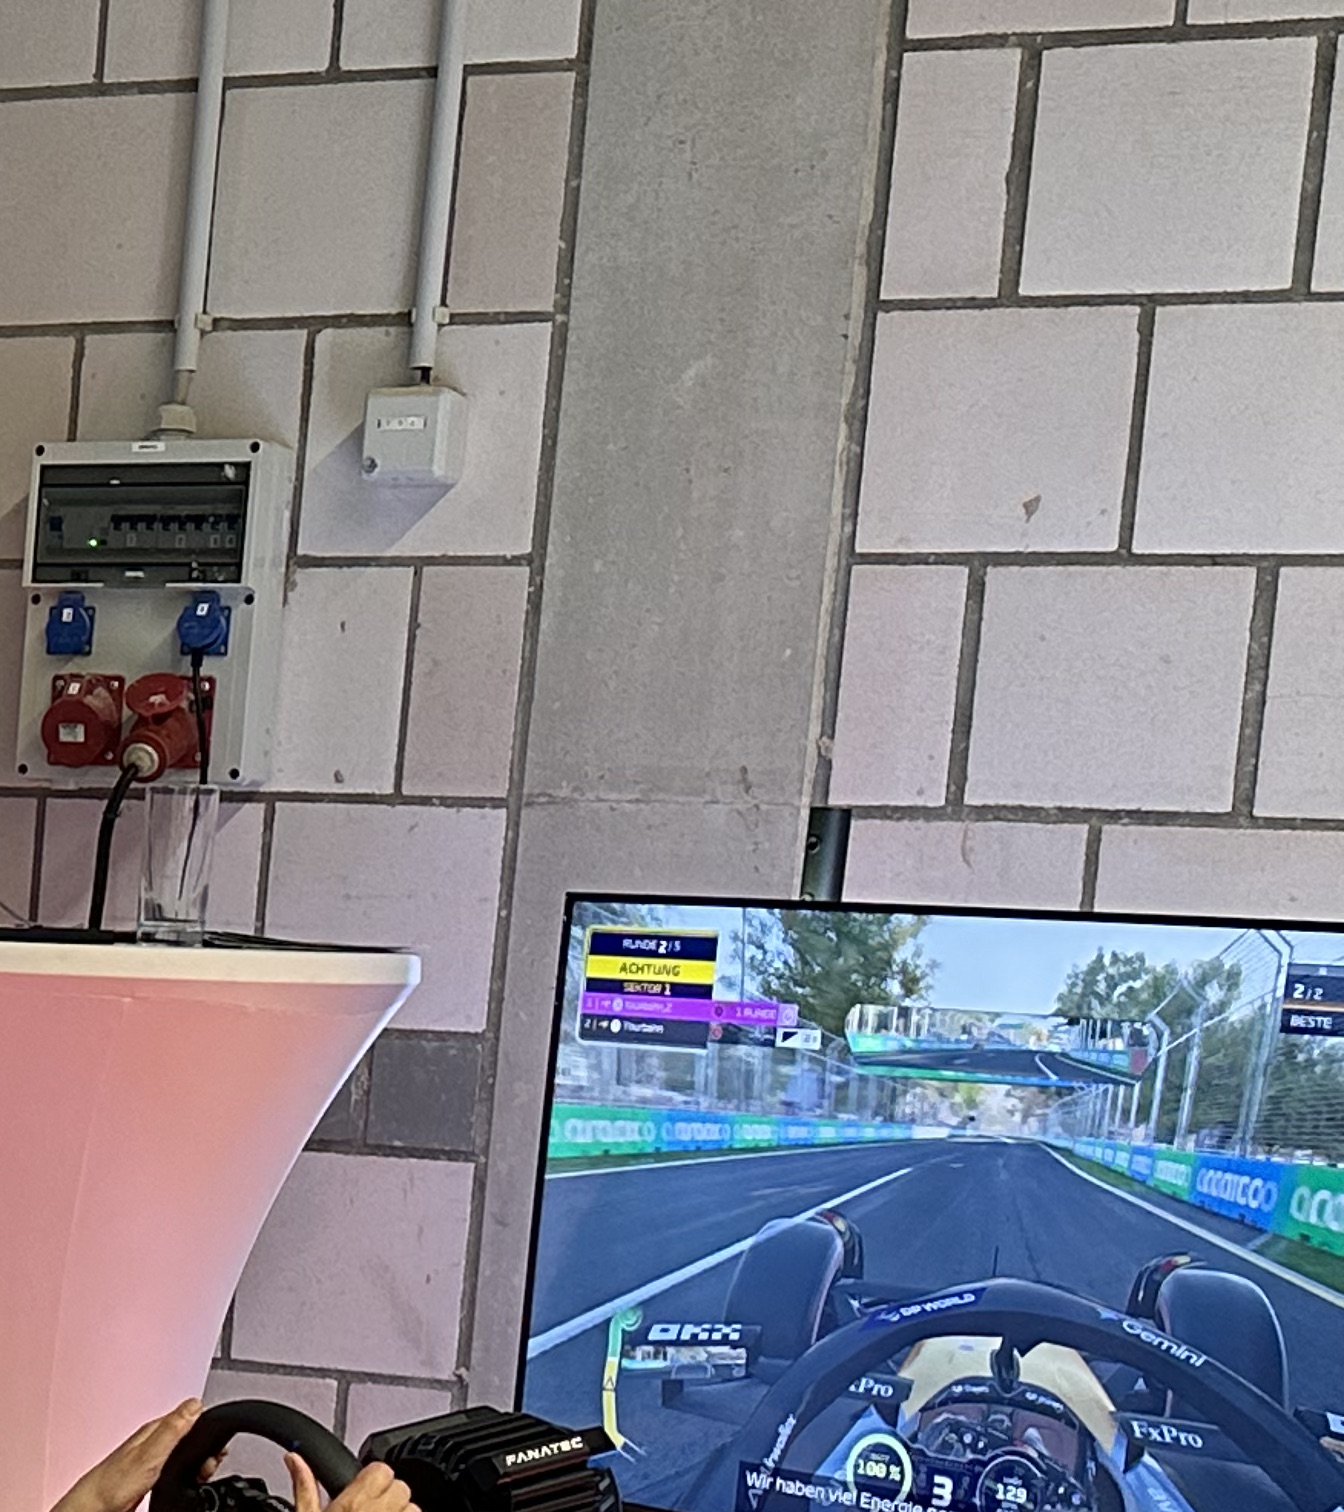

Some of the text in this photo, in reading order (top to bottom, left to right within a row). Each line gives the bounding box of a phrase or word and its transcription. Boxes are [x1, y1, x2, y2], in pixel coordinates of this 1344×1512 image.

[618, 962, 681, 977] ACHTUNG
[1289, 1013, 1333, 1029] BESTE
[647, 1323, 742, 1341] OKX
[1122, 1318, 1209, 1368] Gemini
[849, 1374, 895, 1398] xPro
[1130, 1420, 1204, 1449] FxPro
[505, 1435, 584, 1467] FANATEC
[745, 1470, 773, 1492] Wir
[775, 1476, 825, 1502] haben
[827, 1487, 857, 1506] viel
[930, 1474, 954, 1507] 3
[995, 1482, 1028, 1504] 129
